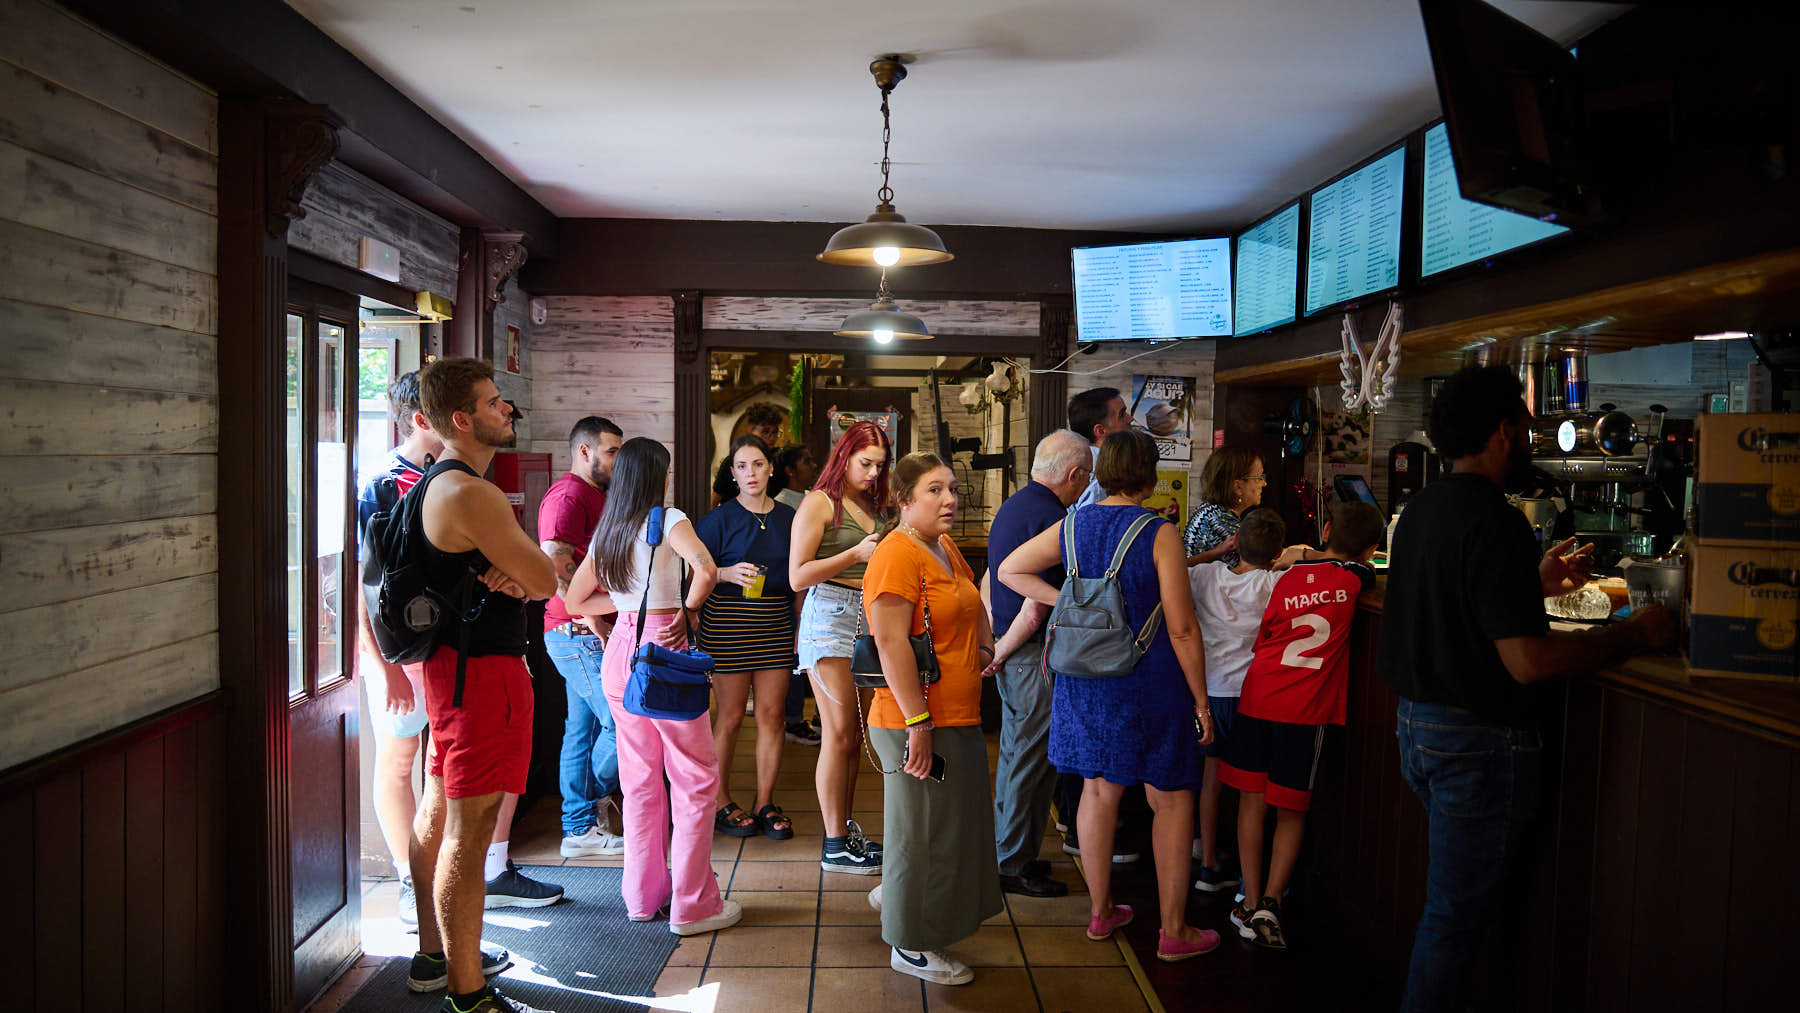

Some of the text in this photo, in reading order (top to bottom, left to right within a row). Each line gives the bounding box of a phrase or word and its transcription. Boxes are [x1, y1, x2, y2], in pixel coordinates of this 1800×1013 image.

[1166, 383, 1183, 391] CAE
[1284, 589, 1348, 611] MARC.B
[1280, 613, 1331, 670] 2
